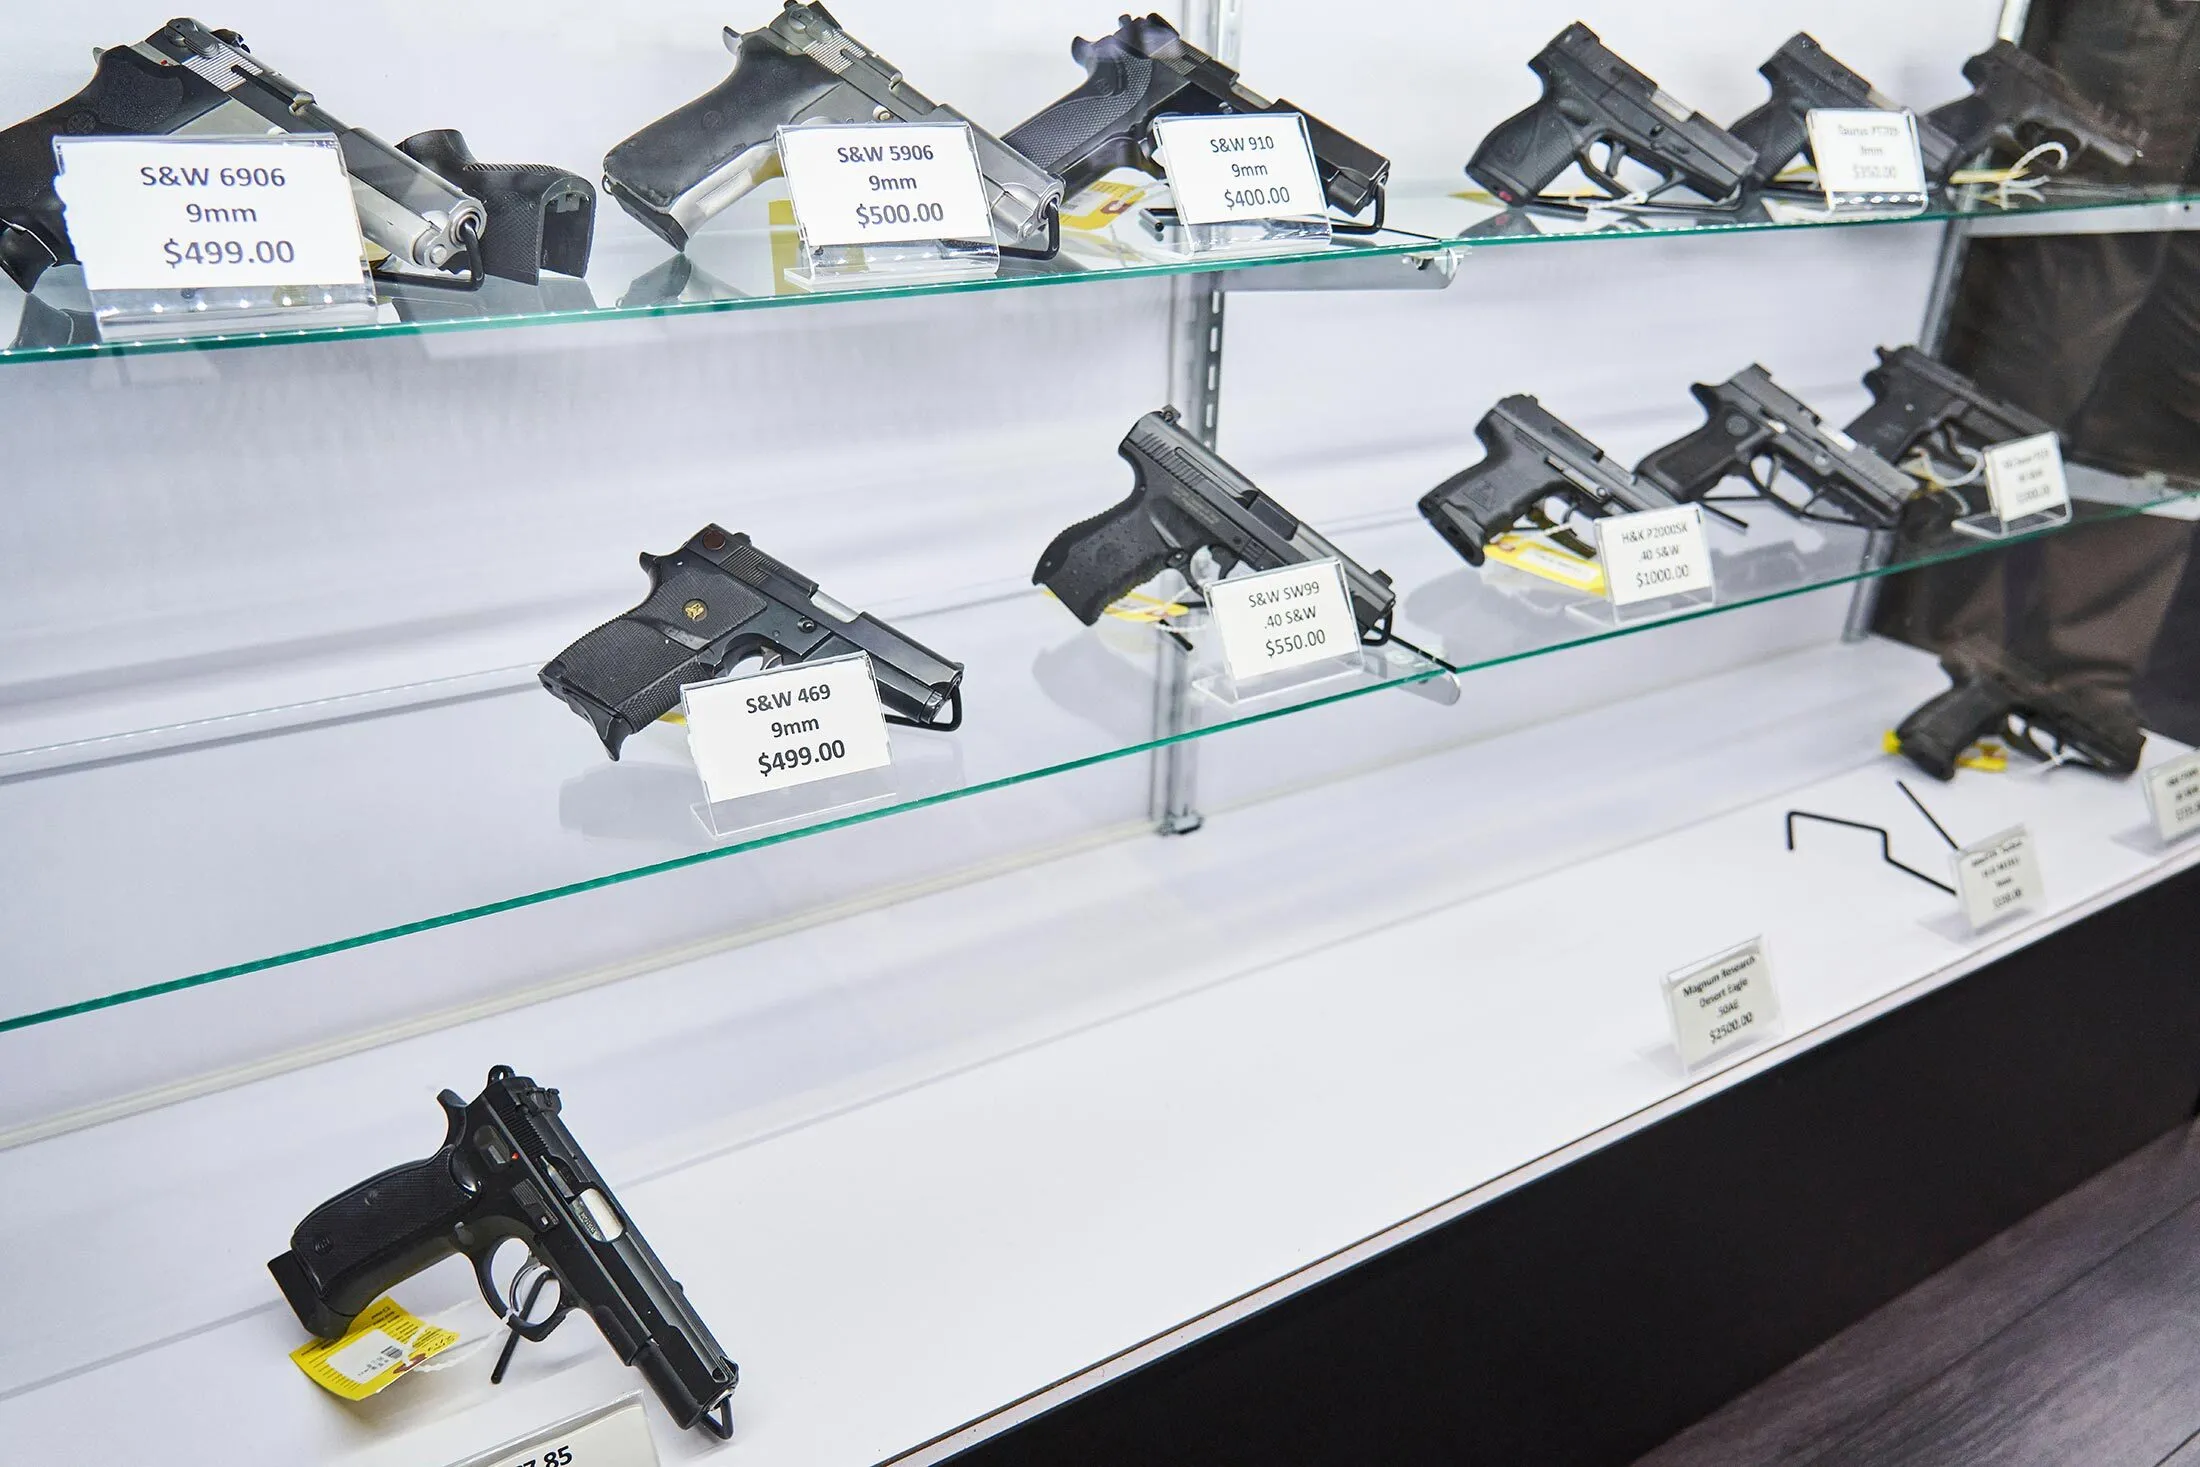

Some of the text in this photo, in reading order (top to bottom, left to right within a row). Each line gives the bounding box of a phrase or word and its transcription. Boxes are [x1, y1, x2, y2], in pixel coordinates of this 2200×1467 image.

[838, 145, 933, 163] S&W 5906
[1210, 136, 1274, 153] S&W 910
[141, 167, 285, 186] S&W 6906
[1232, 164, 1267, 177] 9mm
[869, 175, 917, 191] 9mm
[1224, 187, 1290, 210] $400.00
[186, 204, 256, 222] 9mm
[856, 203, 943, 228] $500.00
[164, 238, 294, 269] $499.00
[1636, 564, 1688, 588] $1000.00
[1249, 581, 1319, 608] S&W SW99
[1265, 606, 1315, 629] .40 S&W
[1265, 629, 1326, 658] $550.00
[746, 684, 830, 713] S&W 469
[772, 719, 819, 738] 9mm
[758, 739, 845, 777] $499.00
[1683, 955, 1755, 997] Magnum Research
[1699, 990, 1726, 1008] Desert
[1709, 1011, 1753, 1044] $2500.00
